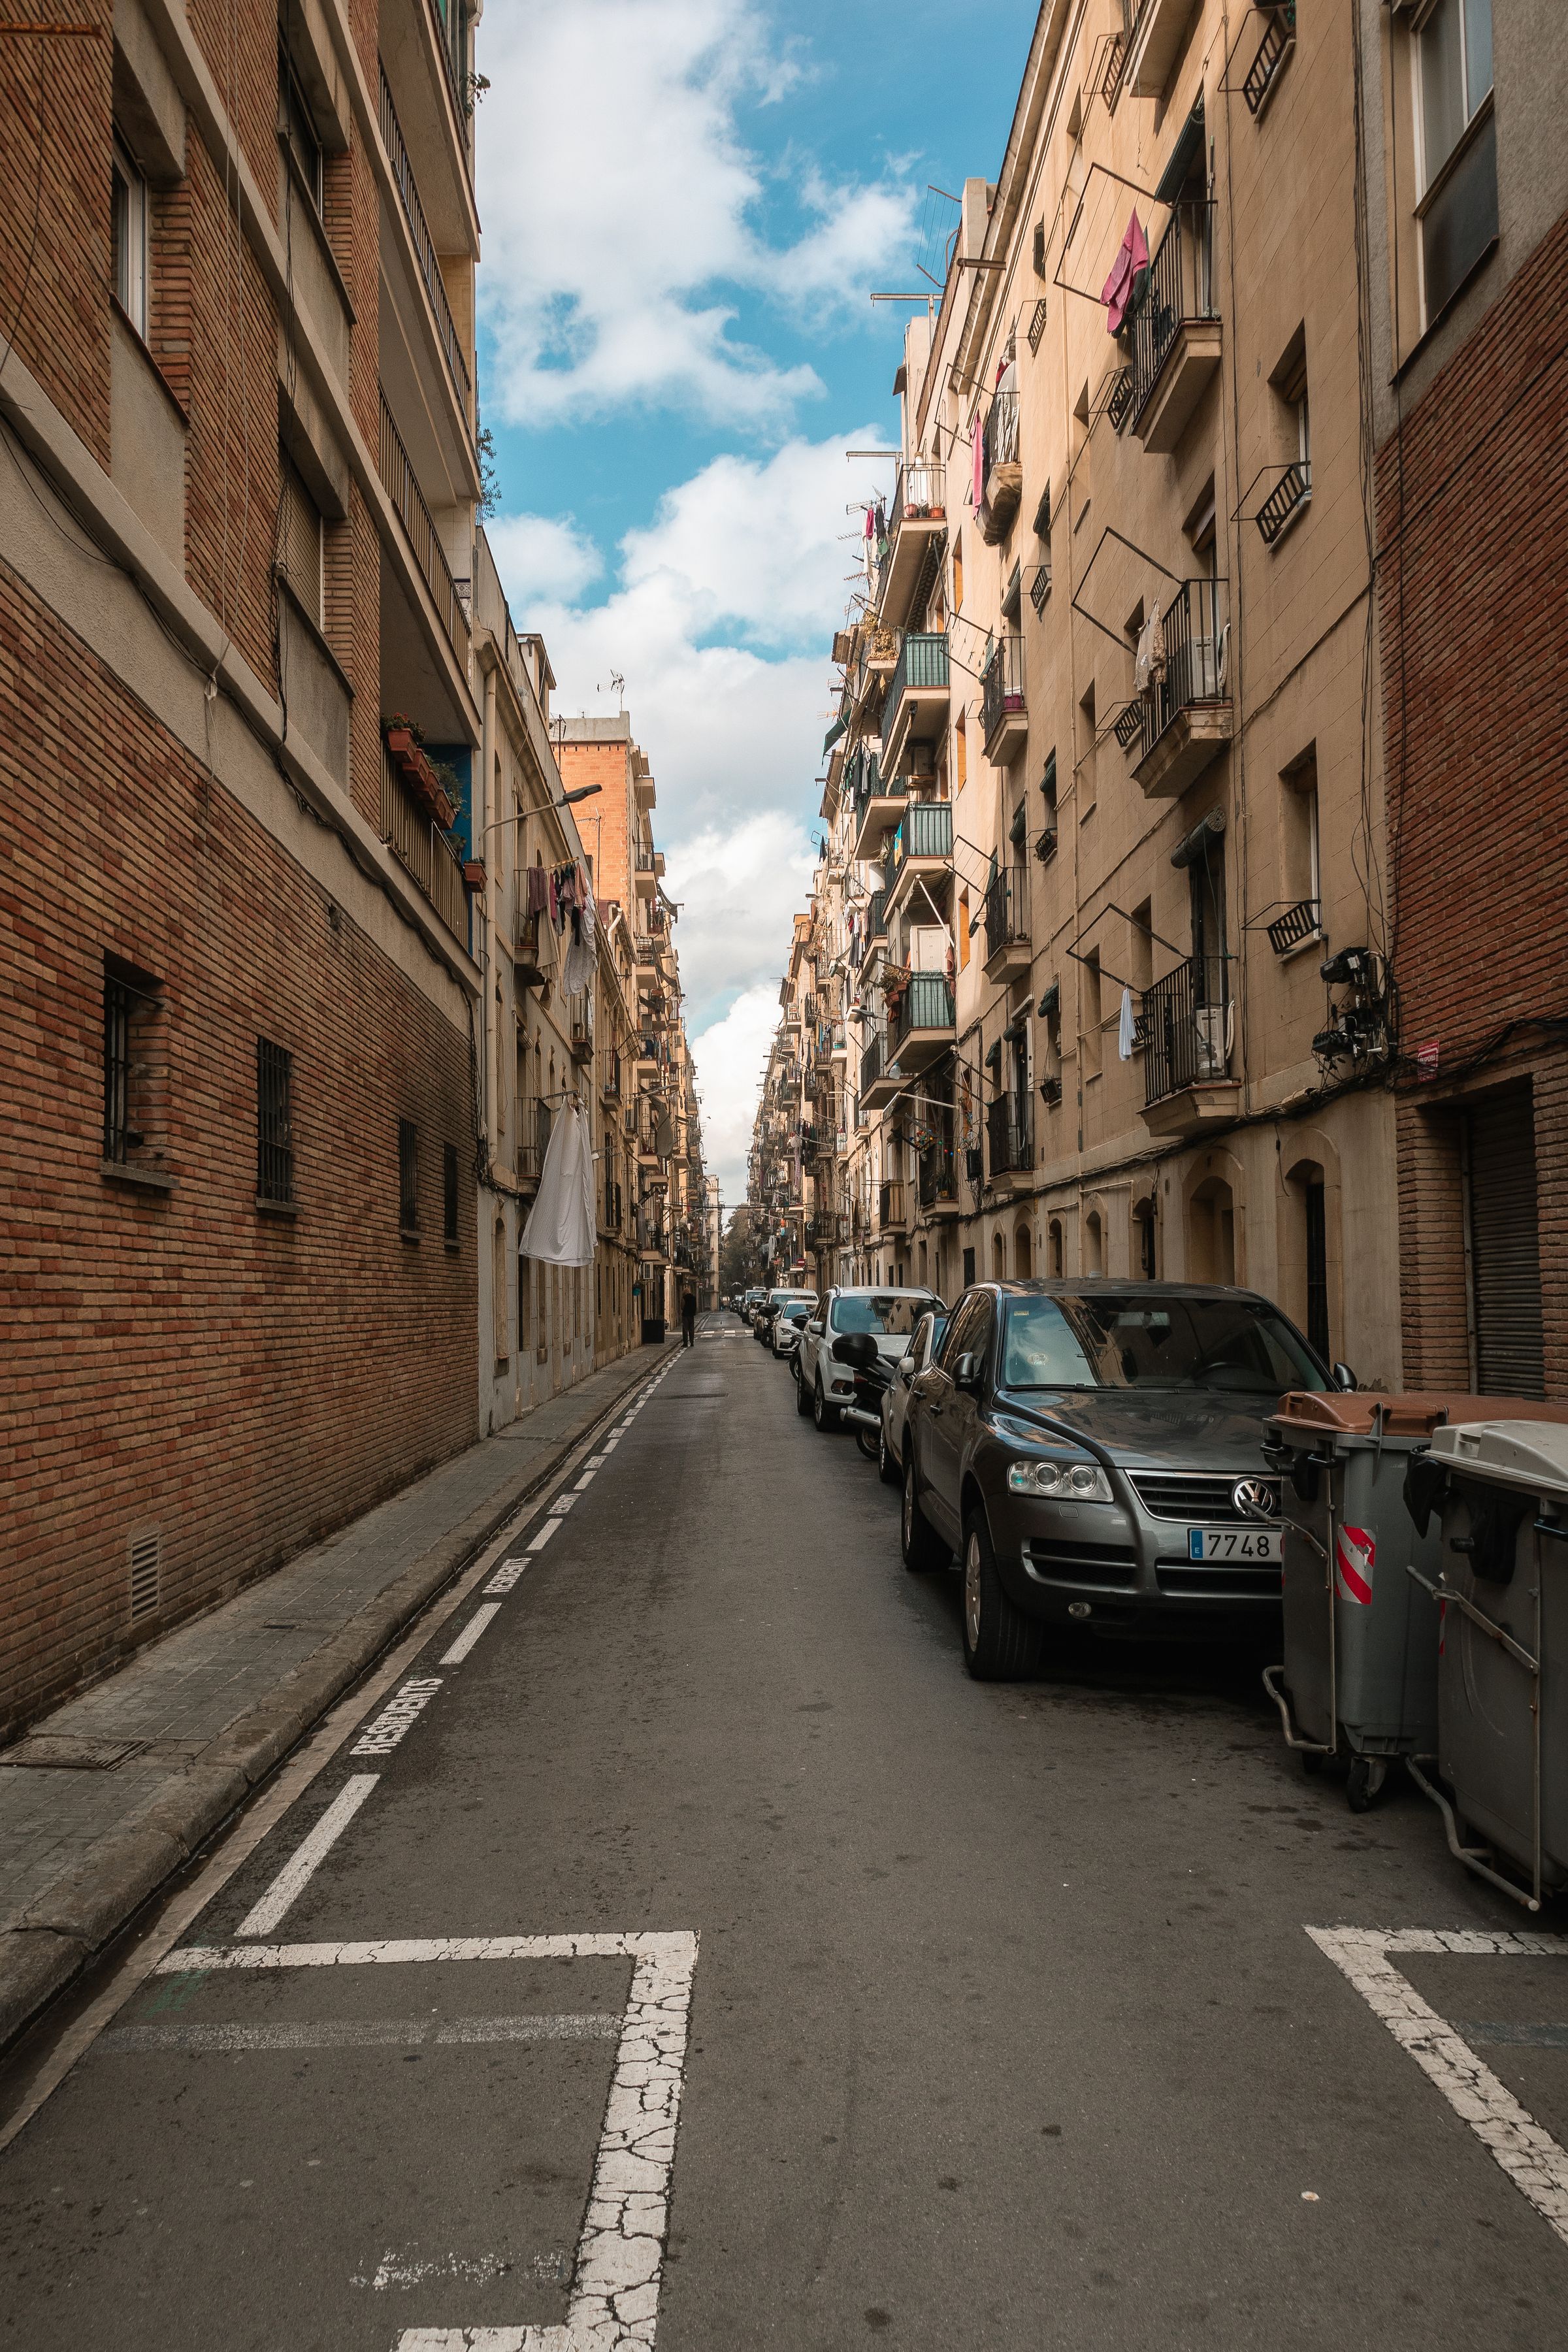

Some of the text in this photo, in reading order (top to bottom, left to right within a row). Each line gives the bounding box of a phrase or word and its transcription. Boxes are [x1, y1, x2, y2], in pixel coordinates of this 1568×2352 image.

[1209, 1534, 1270, 1558] 7748
[482, 1558, 532, 1593] RESIDENTS
[349, 1678, 444, 1755] RESIDENTS
